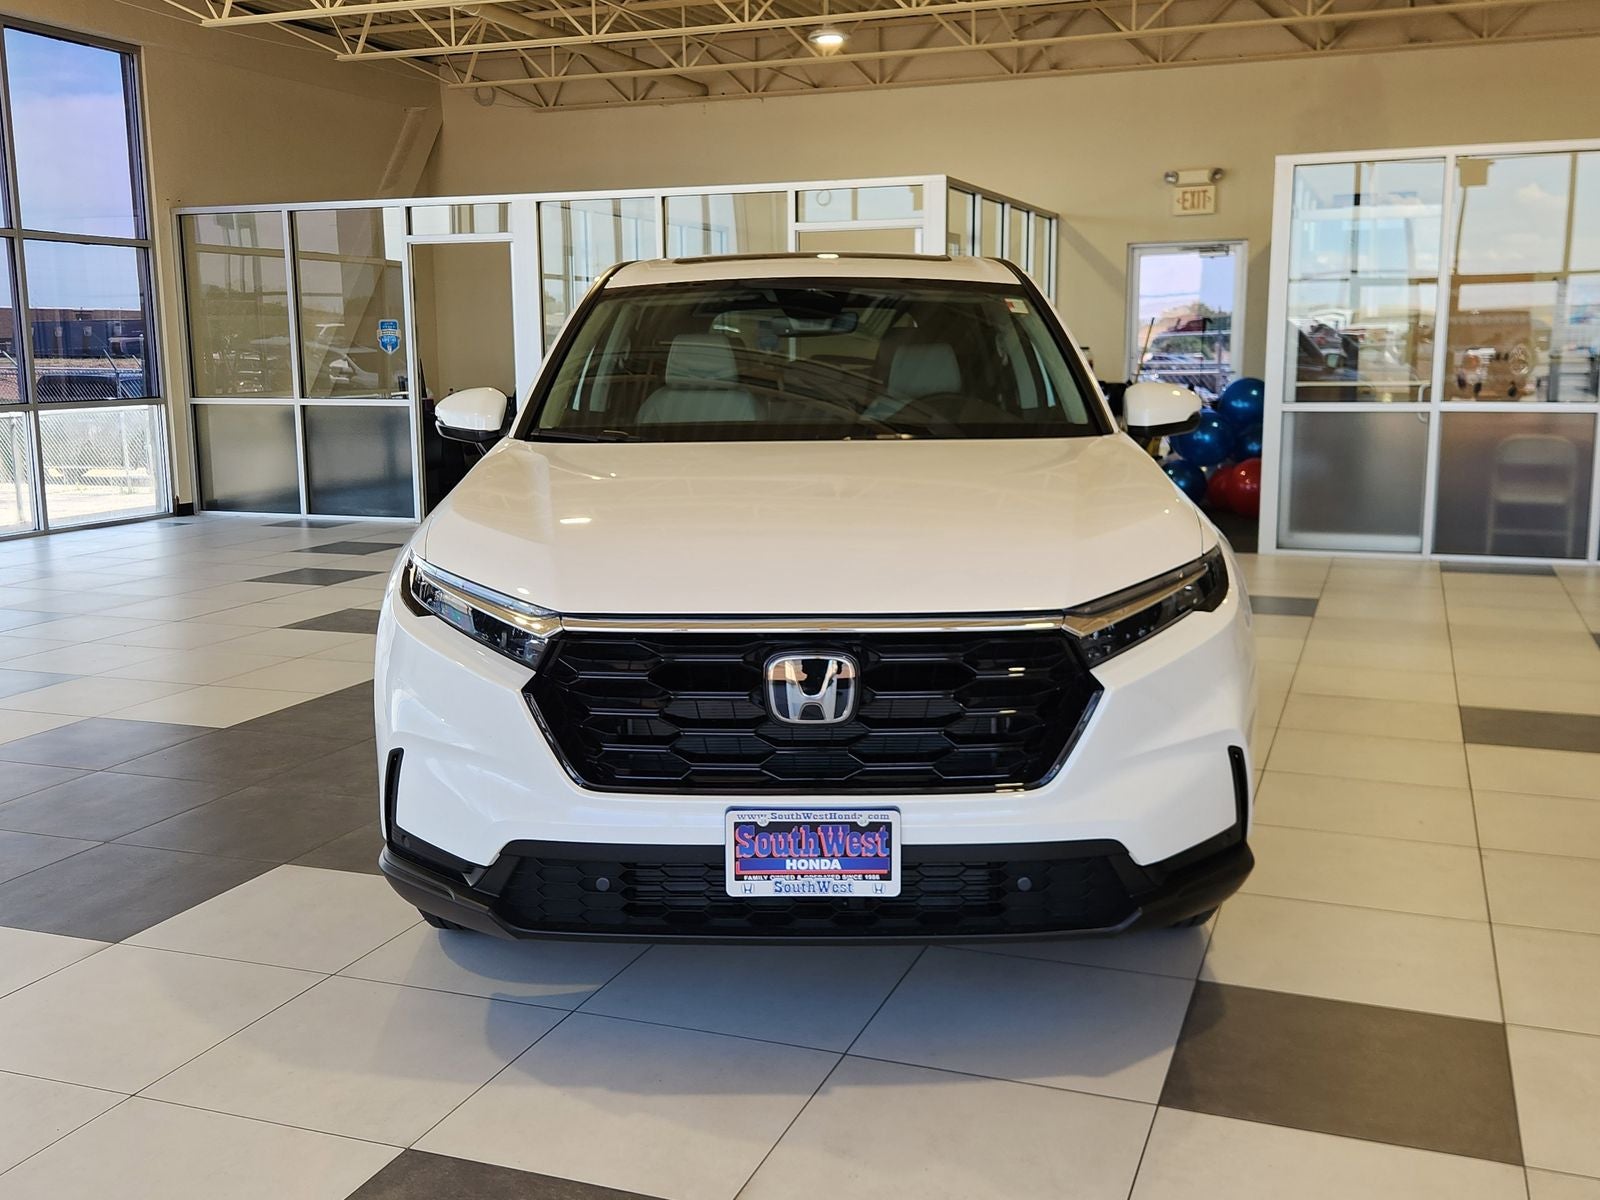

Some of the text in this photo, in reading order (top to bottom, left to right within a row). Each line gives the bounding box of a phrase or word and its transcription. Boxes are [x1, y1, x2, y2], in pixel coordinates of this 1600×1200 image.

[1182, 190, 1208, 210] EXIT
[737, 812, 889, 820] www.SouthWestHondacom
[785, 859, 842, 870] HONDA
